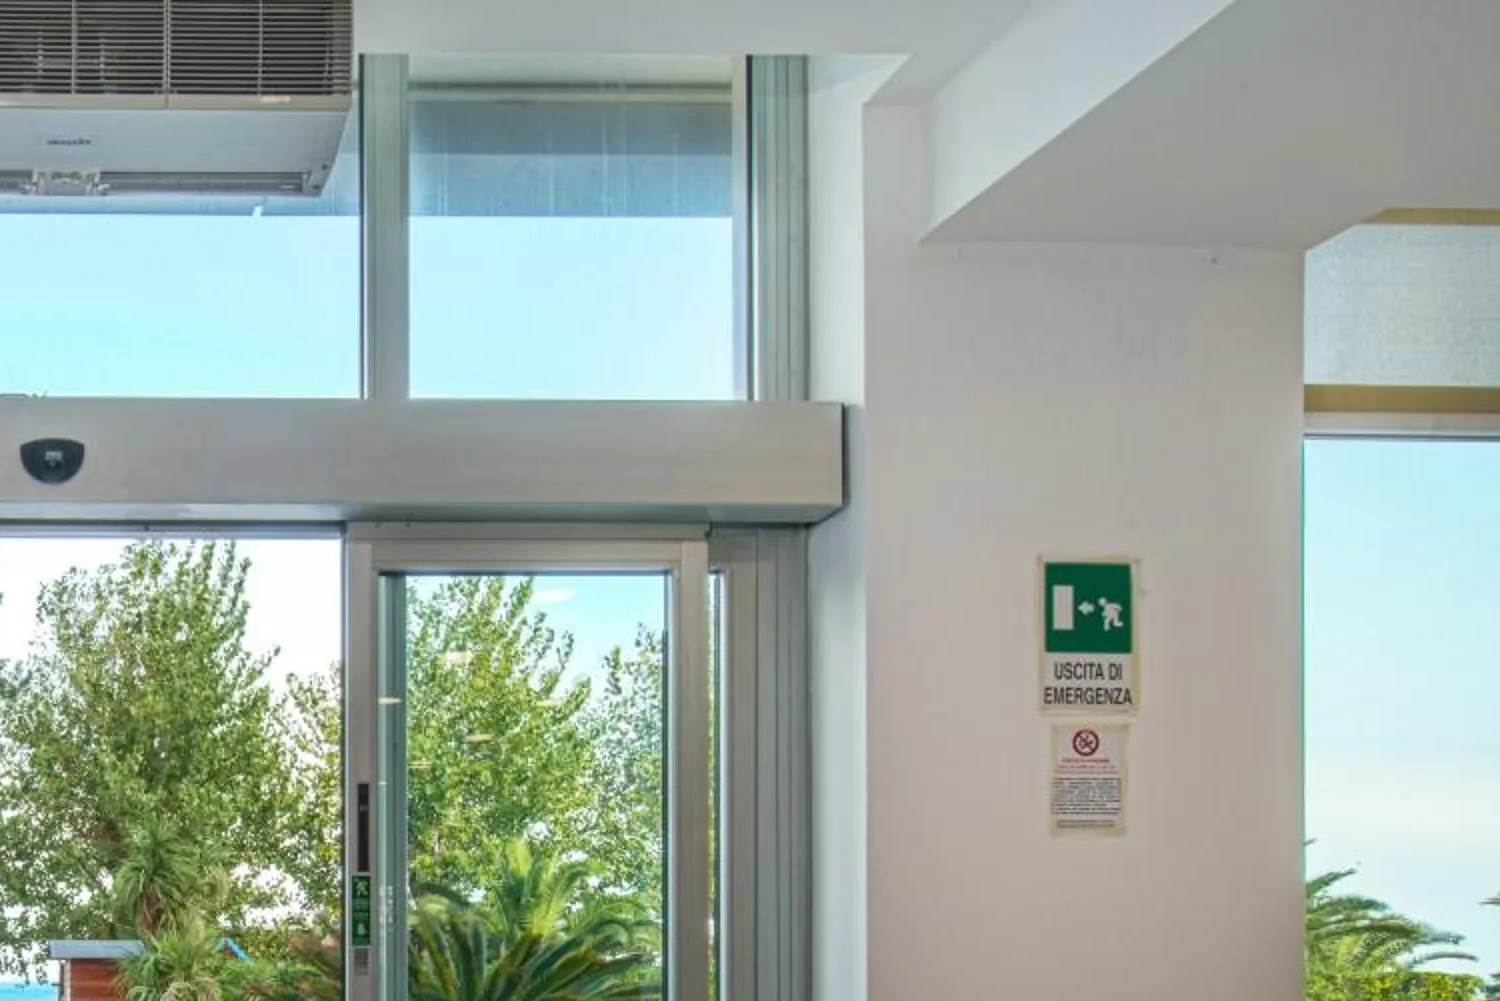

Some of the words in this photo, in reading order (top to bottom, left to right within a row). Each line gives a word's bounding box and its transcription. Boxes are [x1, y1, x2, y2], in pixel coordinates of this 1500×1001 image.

[1053, 661, 1105, 680] USCITA
[1108, 662, 1124, 680] DI
[1043, 686, 1133, 705] EMERGENZA
